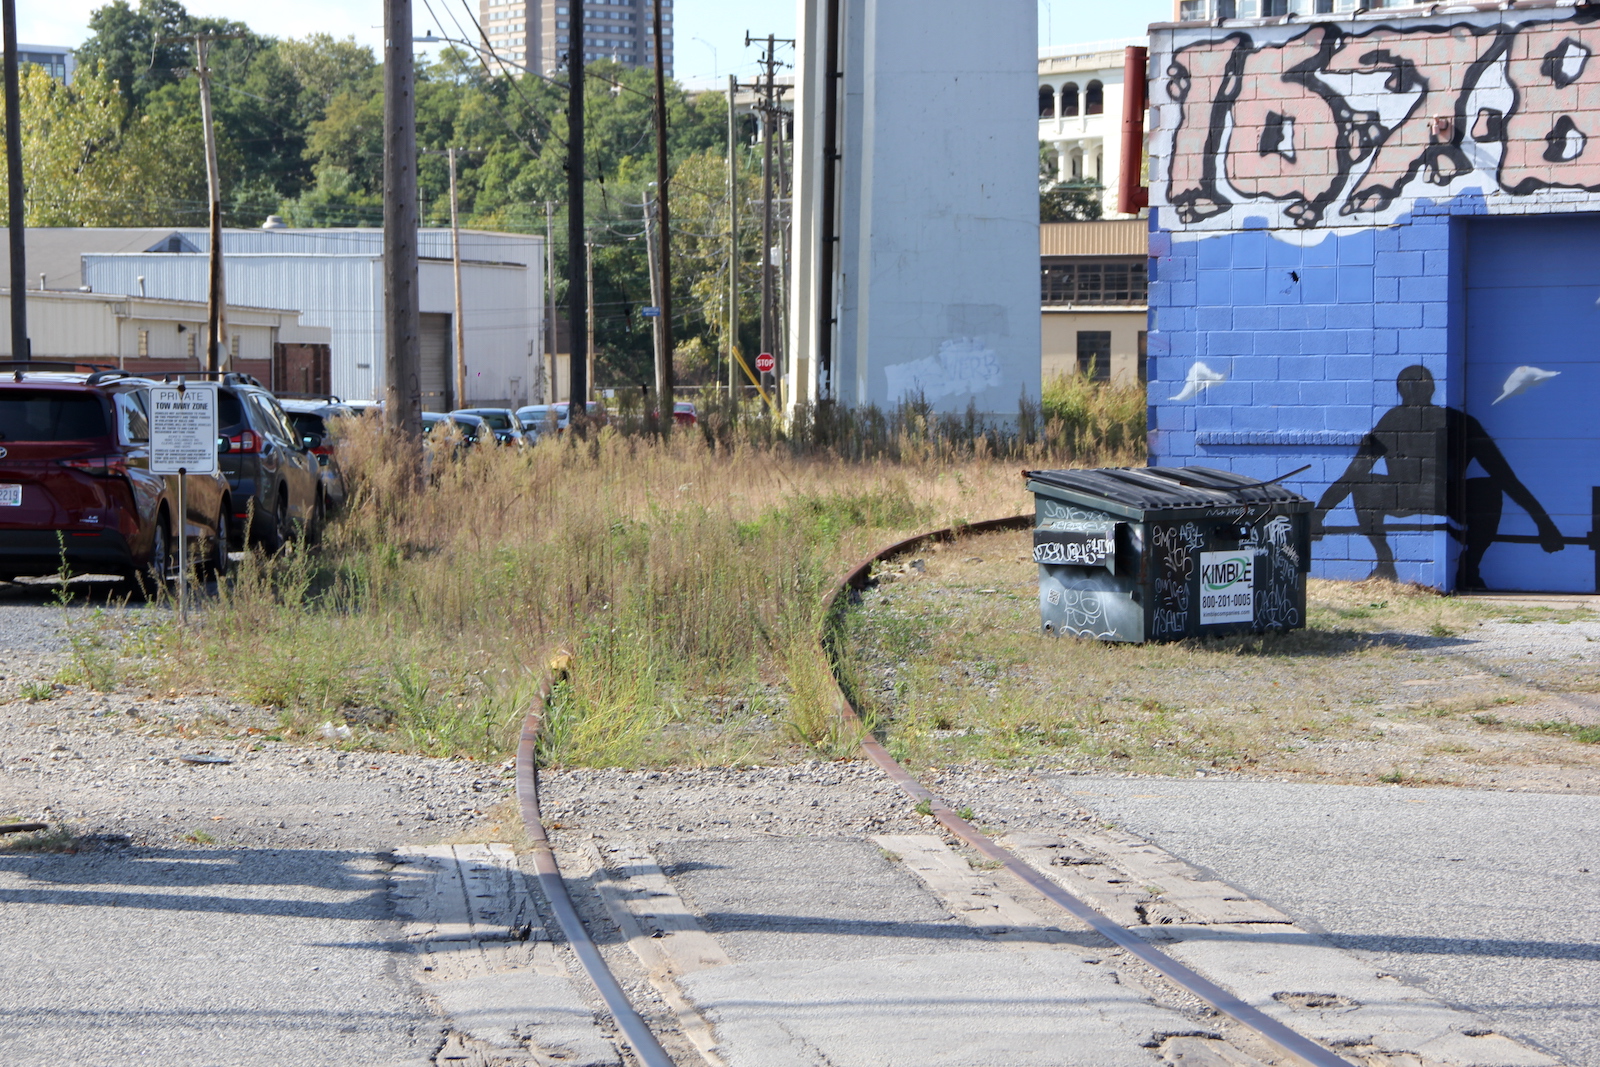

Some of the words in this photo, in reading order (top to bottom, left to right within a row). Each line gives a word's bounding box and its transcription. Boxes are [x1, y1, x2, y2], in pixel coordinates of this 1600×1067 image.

[756, 359, 774, 367] STOP
[160, 391, 204, 401] PRIVATE
[155, 402, 171, 410] TOW
[173, 402, 190, 410] AWAY
[192, 402, 208, 410] ZONE
[1201, 562, 1252, 584] KIMBLE
[1202, 593, 1251, 609] 800-201-0005
[1203, 609, 1250, 617] kimblecompanies.com
